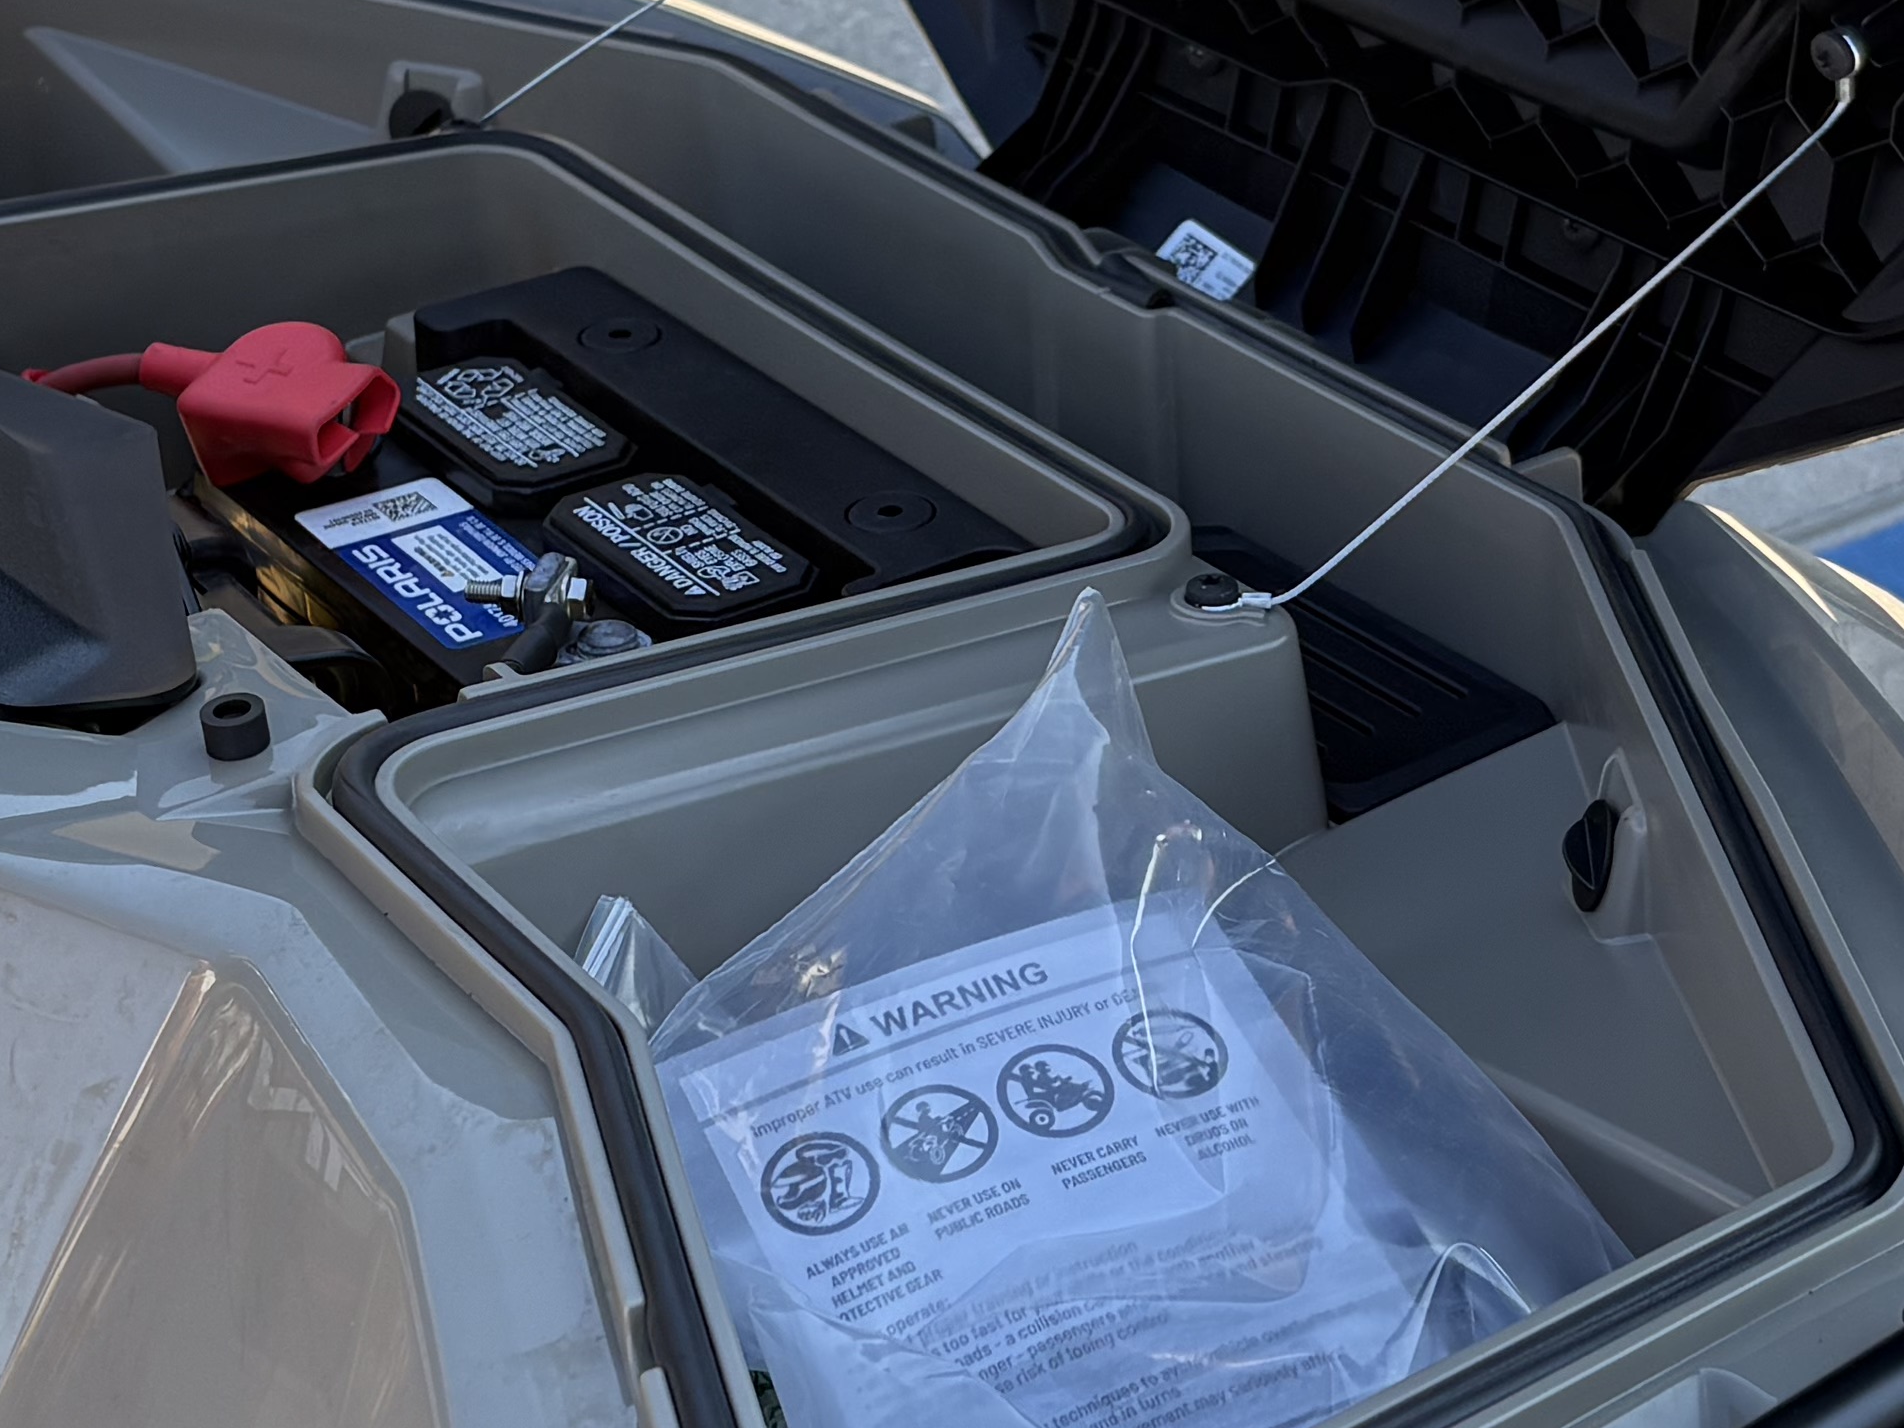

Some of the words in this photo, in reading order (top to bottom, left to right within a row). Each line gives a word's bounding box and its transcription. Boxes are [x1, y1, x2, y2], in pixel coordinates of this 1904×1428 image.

[573, 505, 630, 544] POISON
[630, 548, 693, 589] DANGER
[352, 544, 483, 643] POLARIS
[871, 959, 1049, 1039] WARNING
[750, 1100, 819, 1138] Improper
[824, 1086, 851, 1108] ATV
[855, 1077, 883, 1094] use
[885, 1065, 913, 1083] can
[915, 1047, 959, 1071] result
[958, 1042, 975, 1054] in
[976, 1019, 1036, 1048] SEVERE
[1036, 1002, 1090, 1029] INJURY
[1094, 998, 1108, 1010] or
[1226, 1096, 1260, 1114] WITH
[1051, 1151, 1095, 1175] NEVER
[1095, 1135, 1137, 1158] CARRY
[1061, 1151, 1146, 1189] PASSENGERS
[927, 1197, 972, 1224] NEVER
[972, 1185, 1000, 1204] USE
[1001, 1178, 1021, 1193] ON
[934, 1211, 983, 1240] PUBLIC
[984, 1193, 1029, 1218] ROADS
[806, 1245, 859, 1279] ALWAYS
[859, 1232, 887, 1252] USE
[831, 1247, 900, 1288] APPROVED
[831, 1273, 883, 1308] HELMET
[887, 1260, 916, 1281] AND
[835, 1285, 904, 1326] OTECTIVE
[905, 1269, 943, 1293] GEAR
